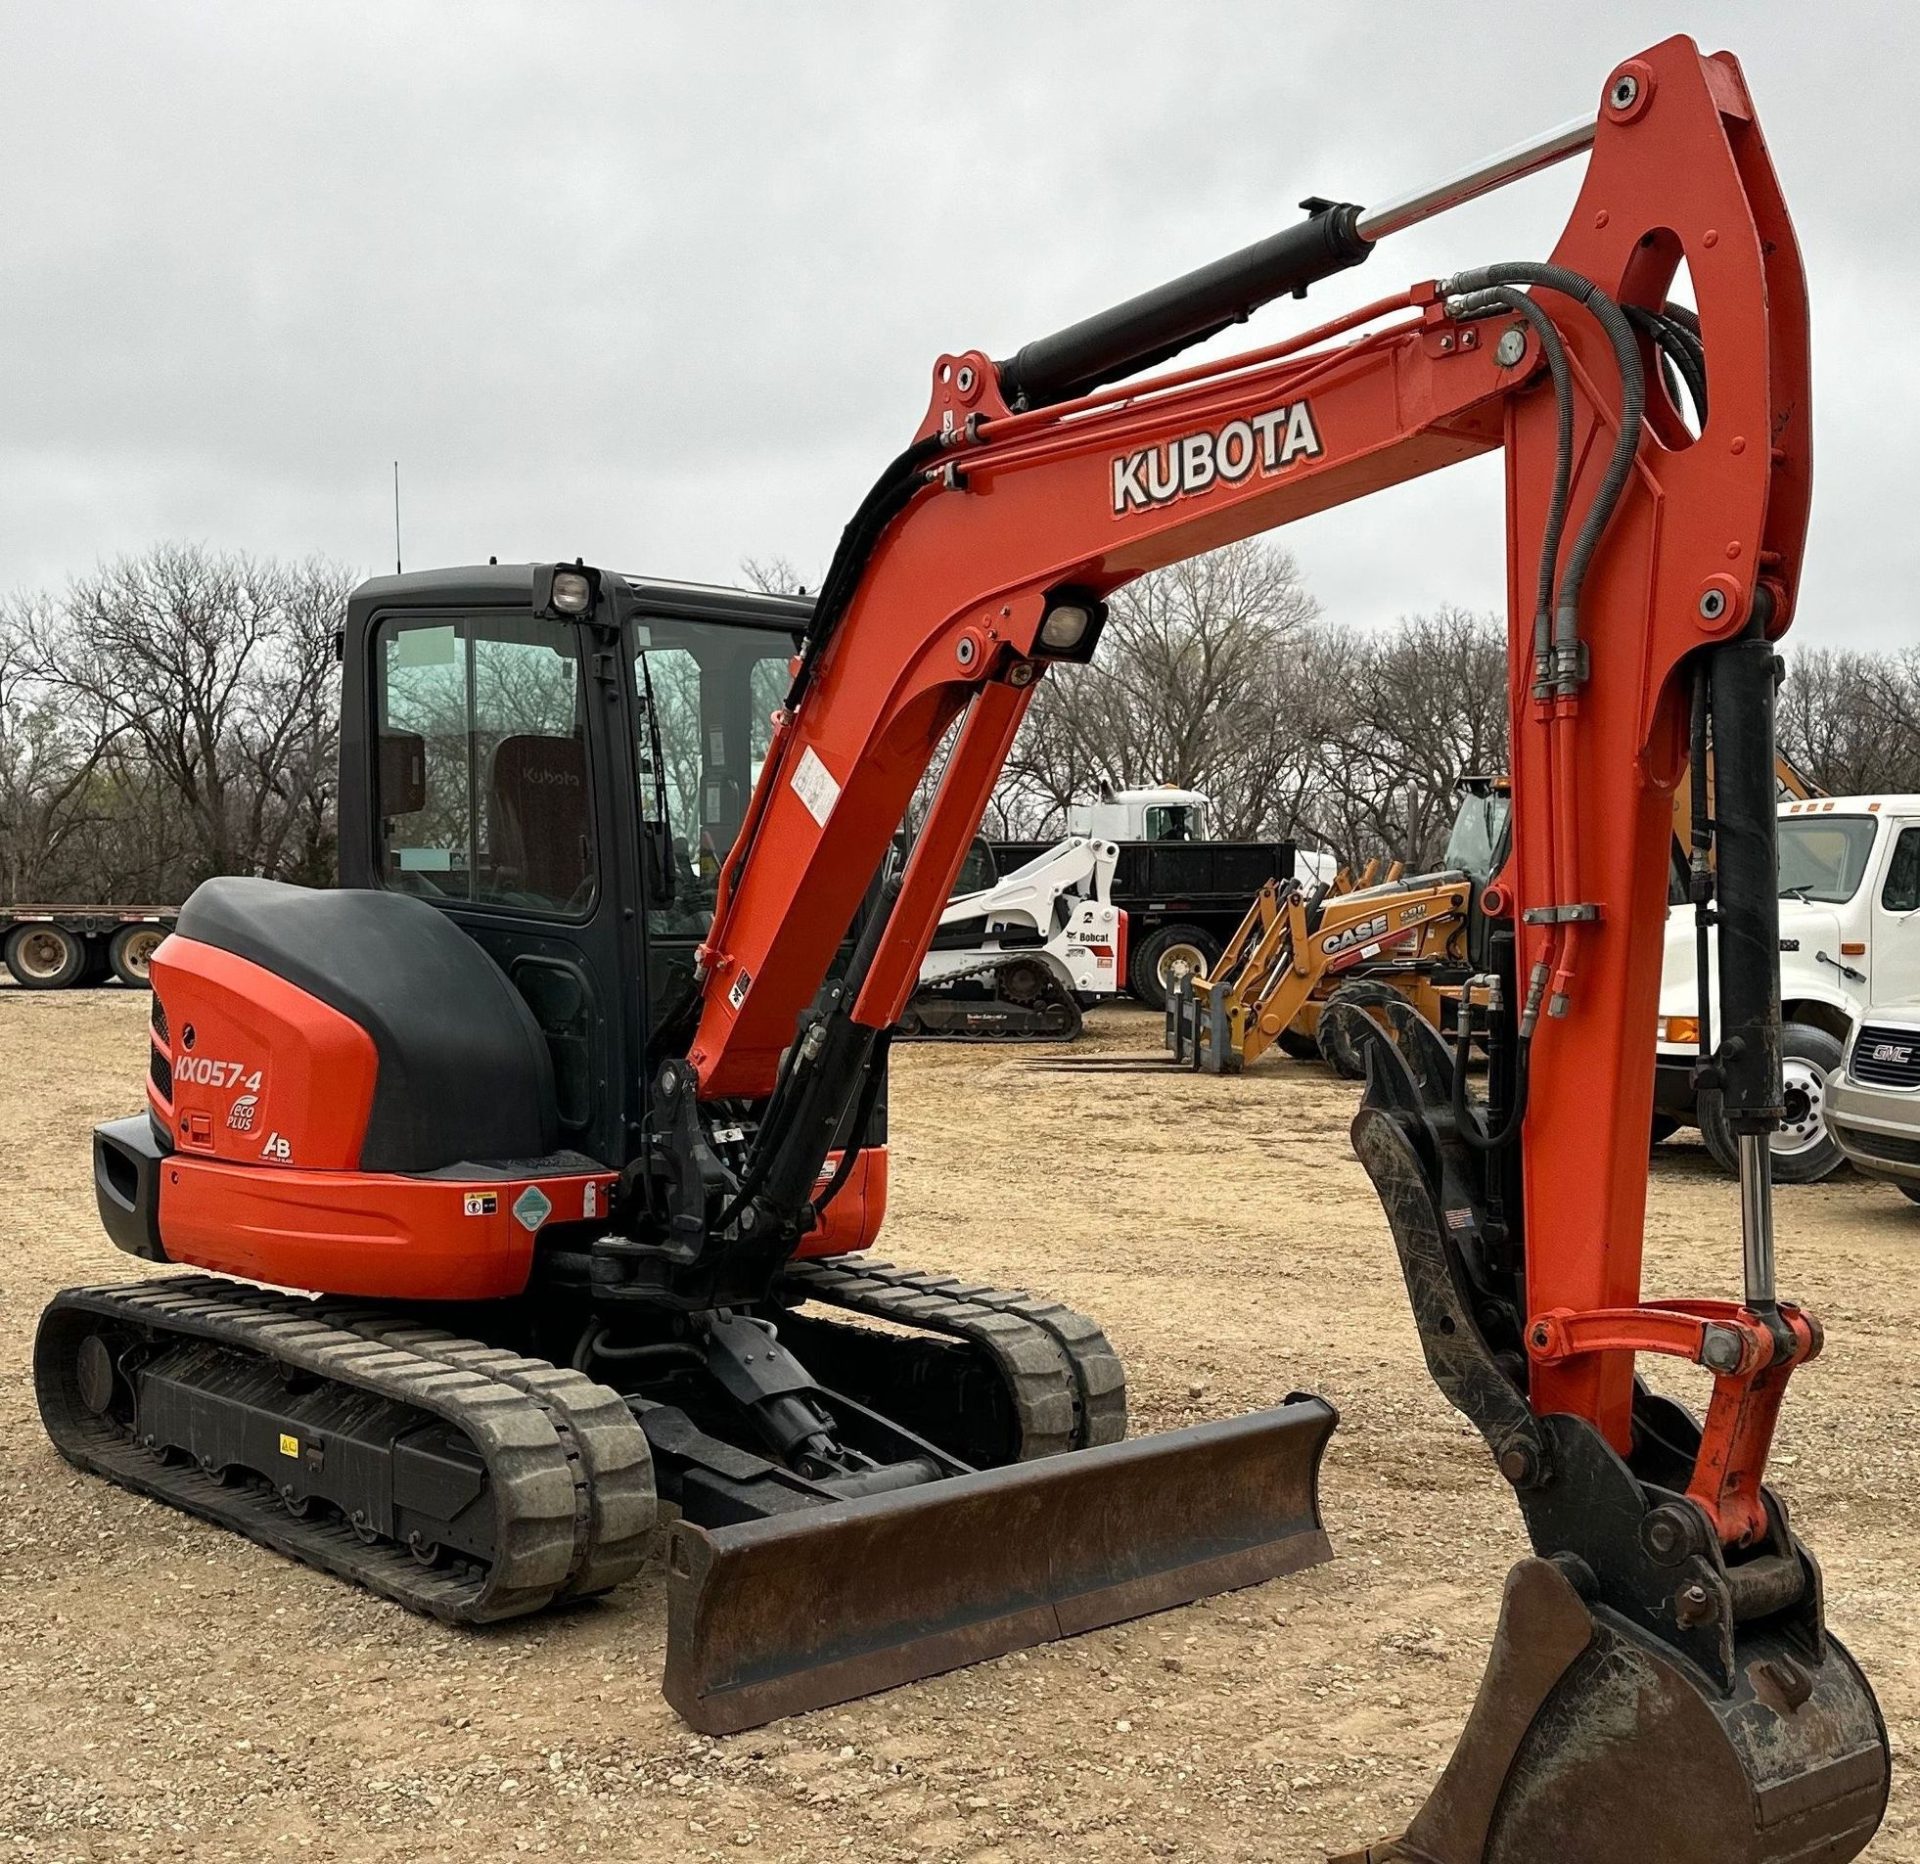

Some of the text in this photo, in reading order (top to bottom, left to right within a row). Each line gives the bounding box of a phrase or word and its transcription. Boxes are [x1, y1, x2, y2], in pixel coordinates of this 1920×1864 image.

[1112, 399, 1321, 513] KUBOTA
[522, 767, 580, 787] Kubota
[1083, 911, 1094, 924] 2
[1080, 932, 1109, 943] Bobcat
[1322, 914, 1388, 955] CASE
[1872, 1044, 1914, 1064] GMC
[174, 1055, 263, 1092] KX057-4
[233, 1104, 255, 1118] eco
[226, 1115, 253, 1131] PLUS
[262, 1131, 291, 1159] AB
